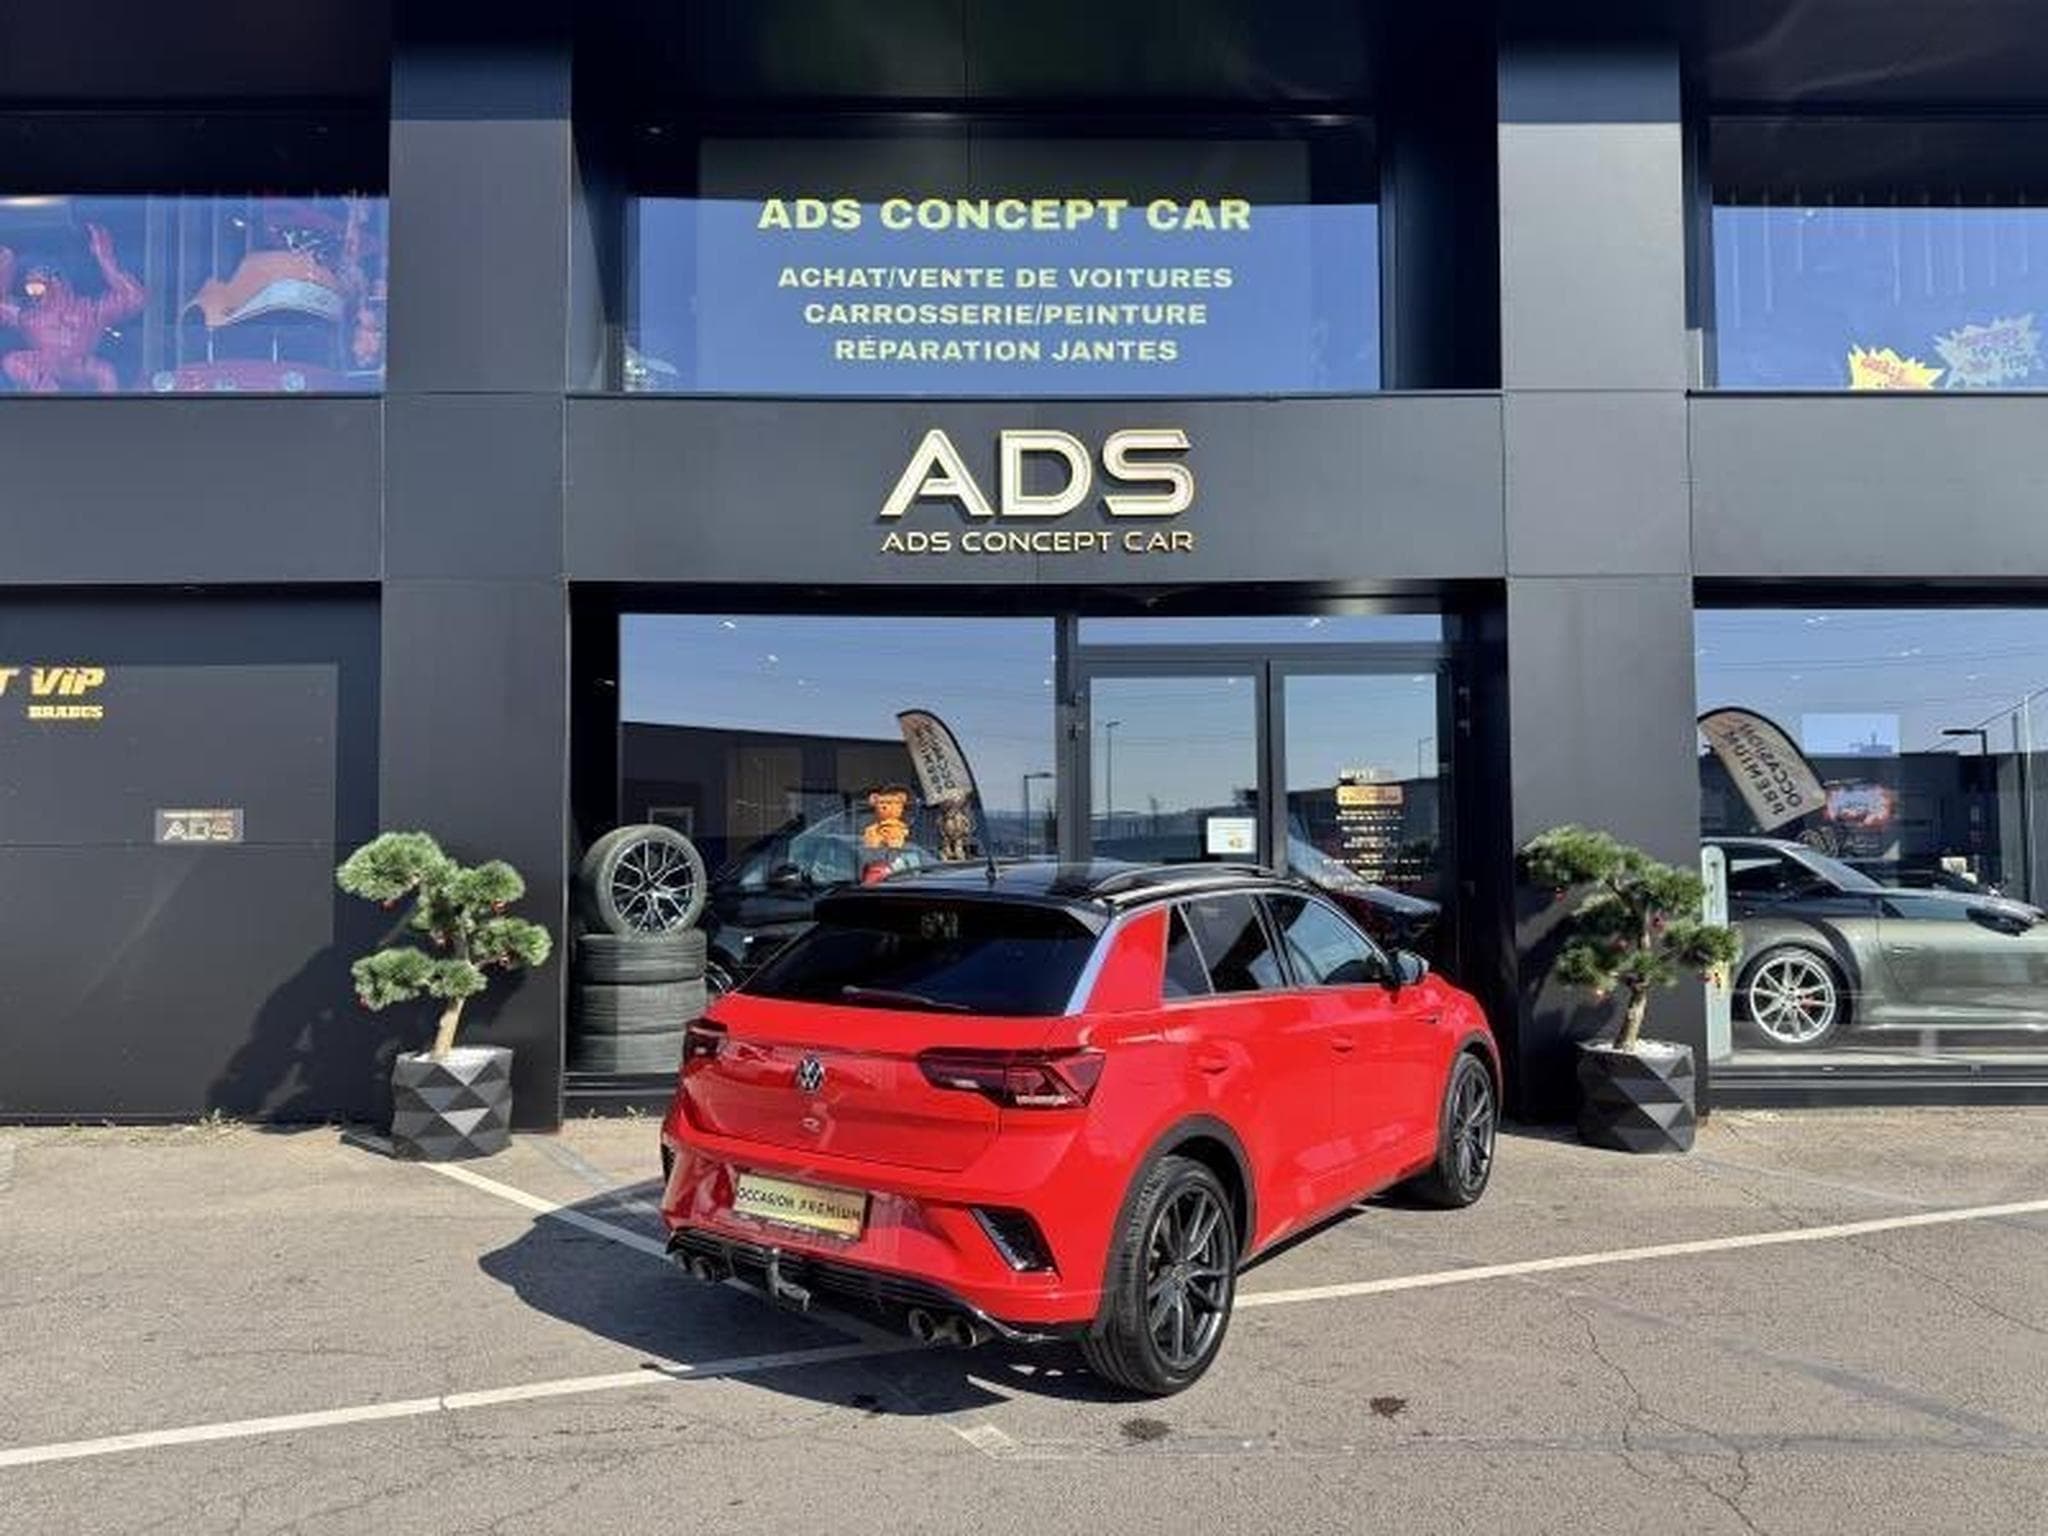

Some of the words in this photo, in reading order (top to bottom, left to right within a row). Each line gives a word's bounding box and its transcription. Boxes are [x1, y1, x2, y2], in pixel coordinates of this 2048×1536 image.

[758, 199, 863, 230] ADS
[880, 199, 1129, 230] CONCEPT
[1146, 199, 1252, 230] CAR
[778, 266, 1005, 289] ACHAT/VENTE
[1015, 267, 1058, 289] DE
[1069, 267, 1234, 289] VOITURES
[804, 302, 1208, 326] CARROSSERIE/PEINTURE
[835, 335, 1041, 361] RÉPARATION
[1052, 340, 1179, 362] JANTES
[879, 428, 1195, 517] ADS
[880, 531, 952, 552] ADS
[961, 531, 1113, 552] CONCEPT
[1124, 531, 1194, 552] CAR
[163, 820, 235, 841] ADS
[737, 1186, 795, 1208] OCCASION
[799, 1199, 861, 1220] PREMIUM
